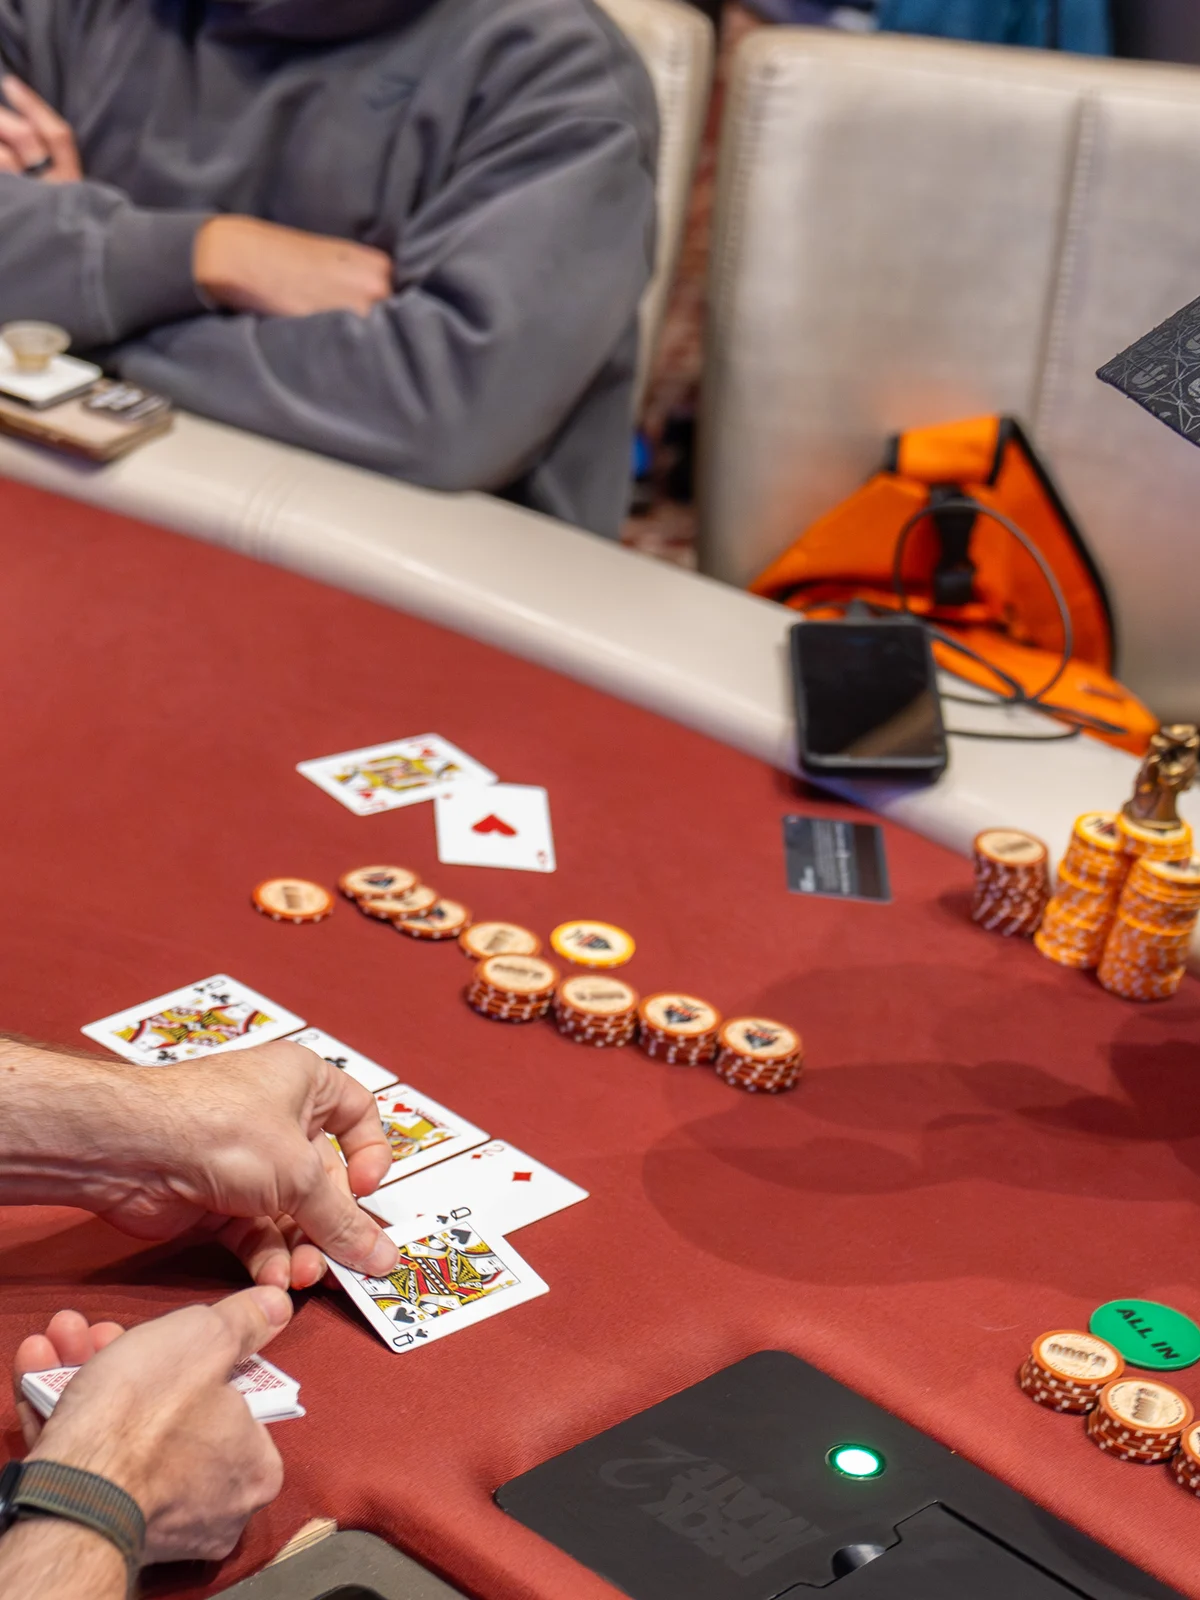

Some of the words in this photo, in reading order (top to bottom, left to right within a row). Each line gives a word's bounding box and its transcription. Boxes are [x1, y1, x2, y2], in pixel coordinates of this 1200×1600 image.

[481, 1143, 506, 1157] 2
[450, 1206, 472, 1221] Q
[392, 1331, 415, 1347] Q
[1115, 1307, 1153, 1339] ALL
[1151, 1340, 1181, 1360] IN
